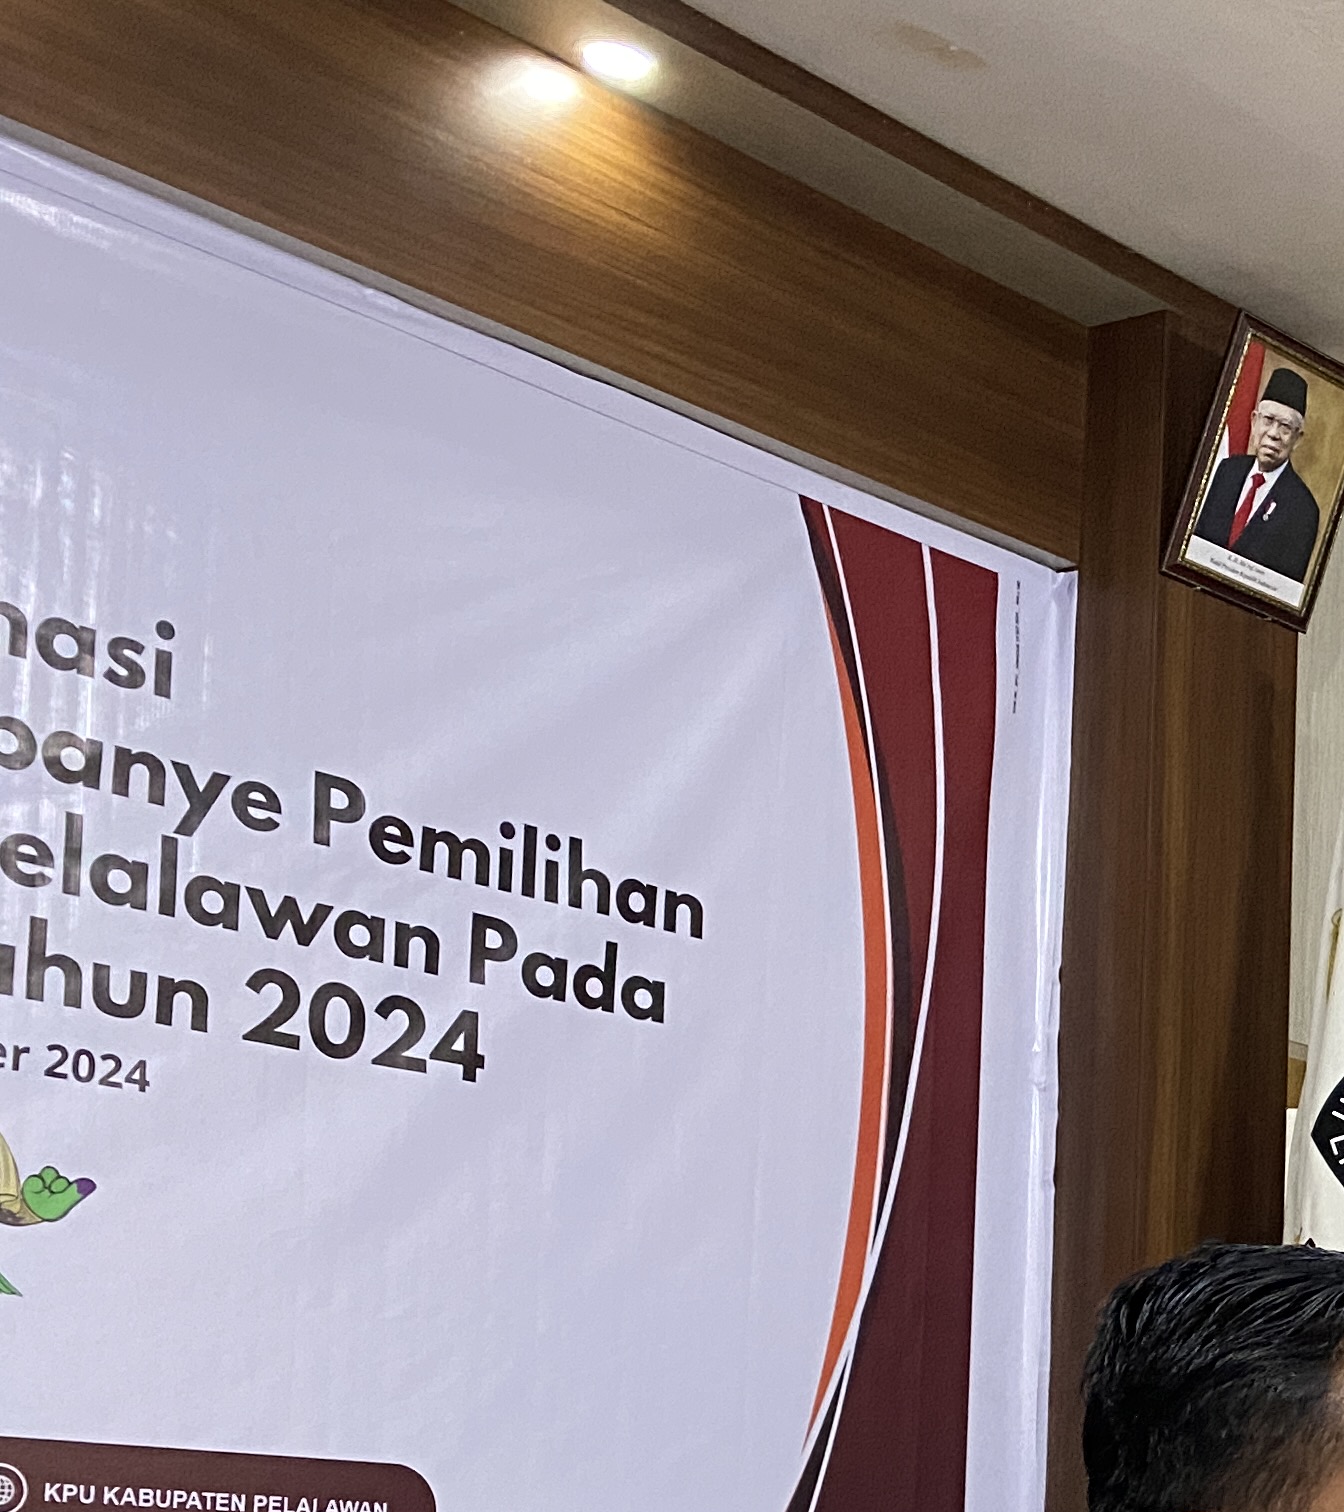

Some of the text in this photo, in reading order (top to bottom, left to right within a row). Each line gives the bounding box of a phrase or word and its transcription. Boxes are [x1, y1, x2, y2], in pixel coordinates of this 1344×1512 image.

[0, 811, 665, 1023] elalawan Pada
[312, 770, 704, 939] Pemilihan
[0, 915, 486, 1083] hun 2024
[44, 1044, 150, 1093] 2024
[43, 1481, 96, 1505] KPU
[102, 1485, 247, 1512] KABUPATEN
